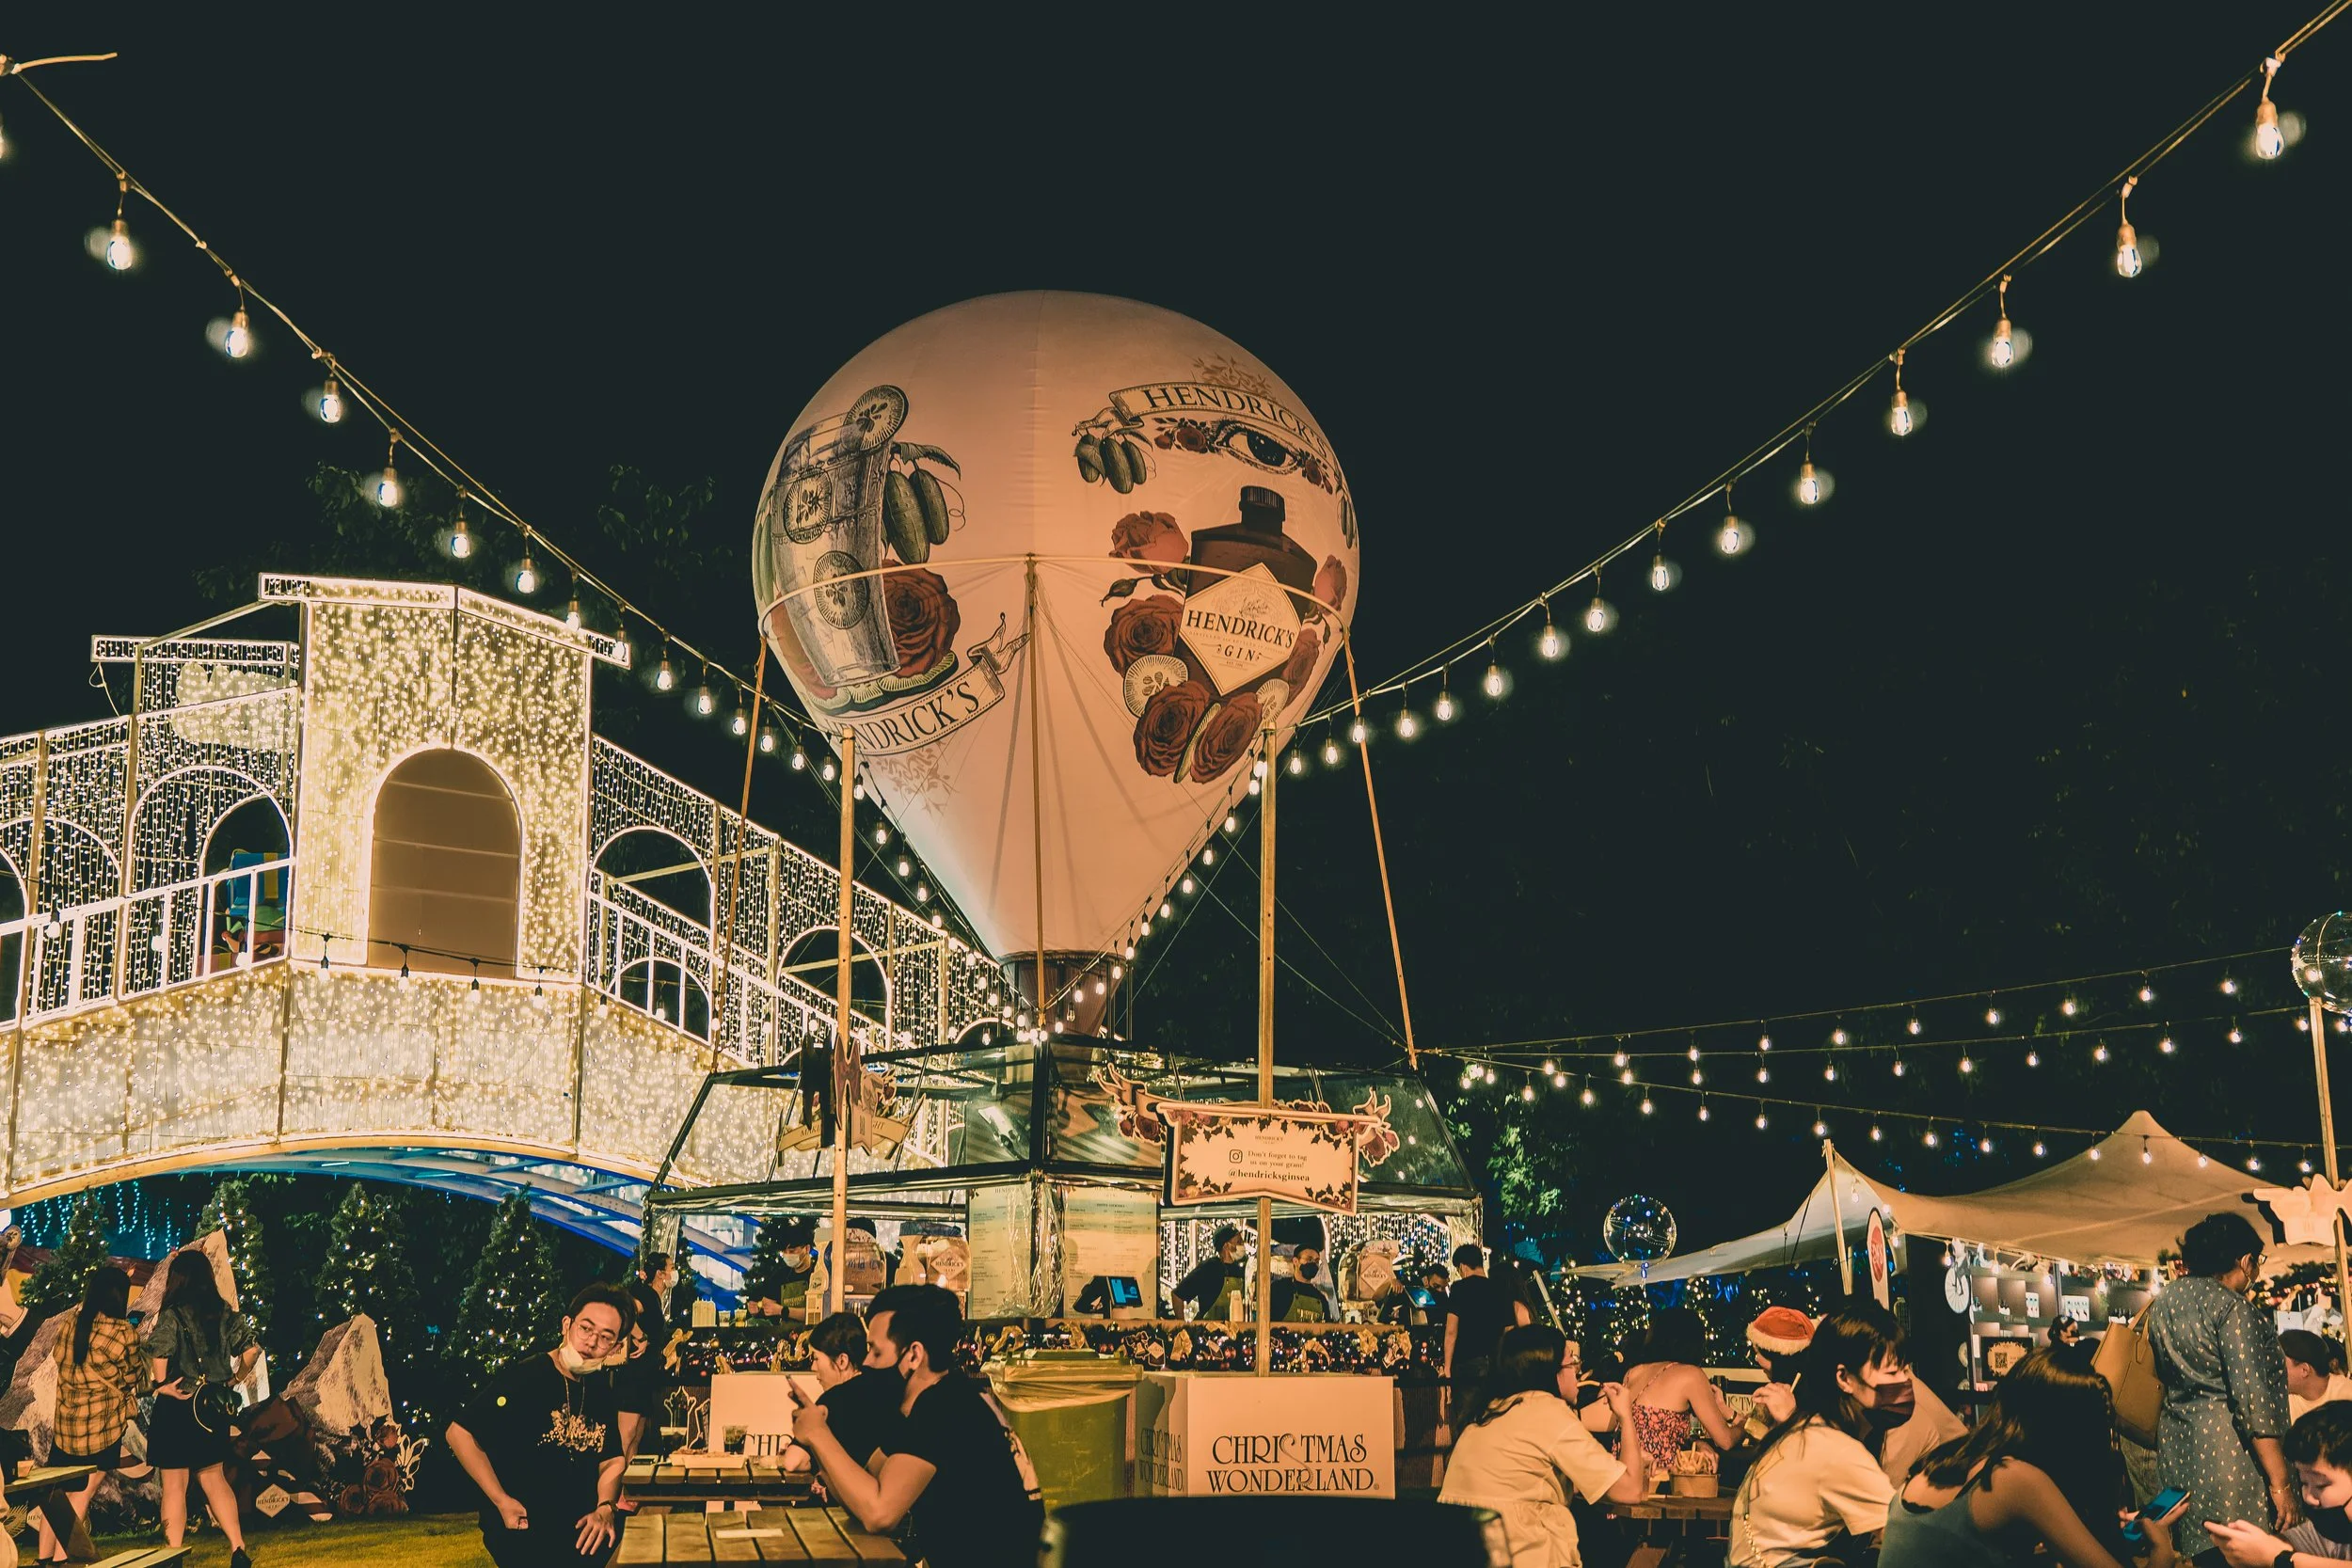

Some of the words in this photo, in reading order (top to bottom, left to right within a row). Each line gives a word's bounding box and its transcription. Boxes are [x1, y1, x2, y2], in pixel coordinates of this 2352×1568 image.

[1142, 387, 1327, 459] HENDRICK'S
[1185, 610, 1295, 649] HENDRICK'S
[1224, 644, 1255, 662] GIN
[1268, 1151, 1287, 1161] forget
[1228, 1169, 1310, 1182] @hendricksginsea
[1140, 1428, 1183, 1464] CHRISTMAS
[1212, 1433, 1368, 1465] CHRISTMAS
